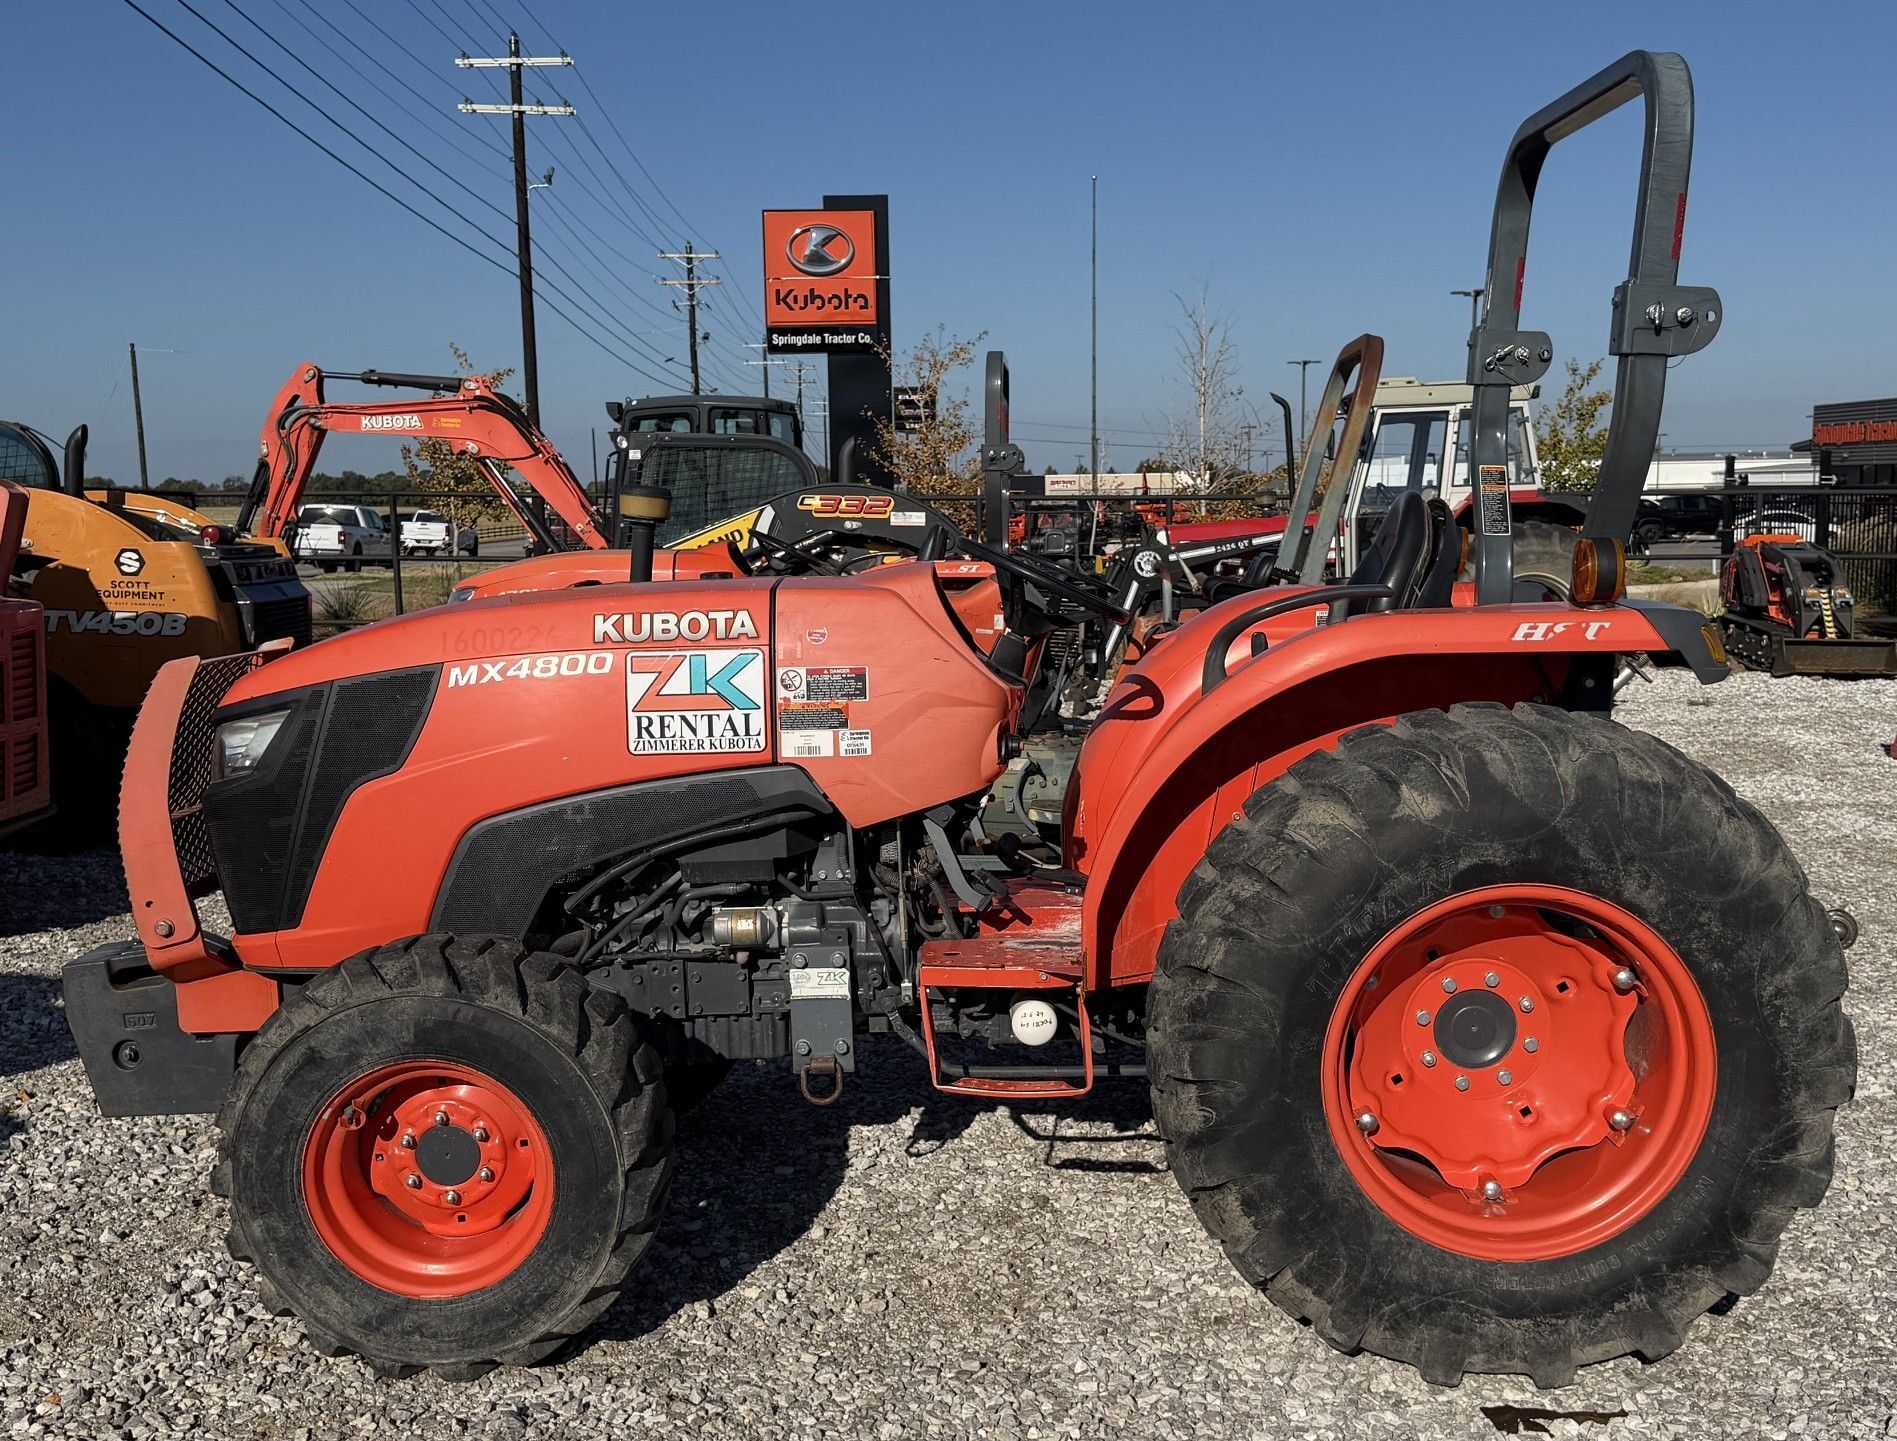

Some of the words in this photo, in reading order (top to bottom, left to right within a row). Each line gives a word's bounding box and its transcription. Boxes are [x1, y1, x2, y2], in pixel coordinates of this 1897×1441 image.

[775, 288, 870, 311] Kubota
[772, 333, 822, 346] Springdale
[823, 333, 856, 344] Tractor
[361, 415, 422, 429] KUBOTA
[798, 495, 894, 517] C332
[957, 565, 979, 573] ST
[111, 580, 150, 590] SCOTT
[96, 589, 165, 601] EQUIPMENT
[44, 609, 188, 636] TV450B
[594, 609, 759, 643] KUBOTA
[447, 652, 614, 688] MX4800
[631, 653, 761, 712] ZK
[635, 713, 762, 740] RENTAL
[633, 739, 706, 752] ZIMMERER
[709, 738, 762, 750] KUBOTA
[816, 971, 848, 985] ZK
